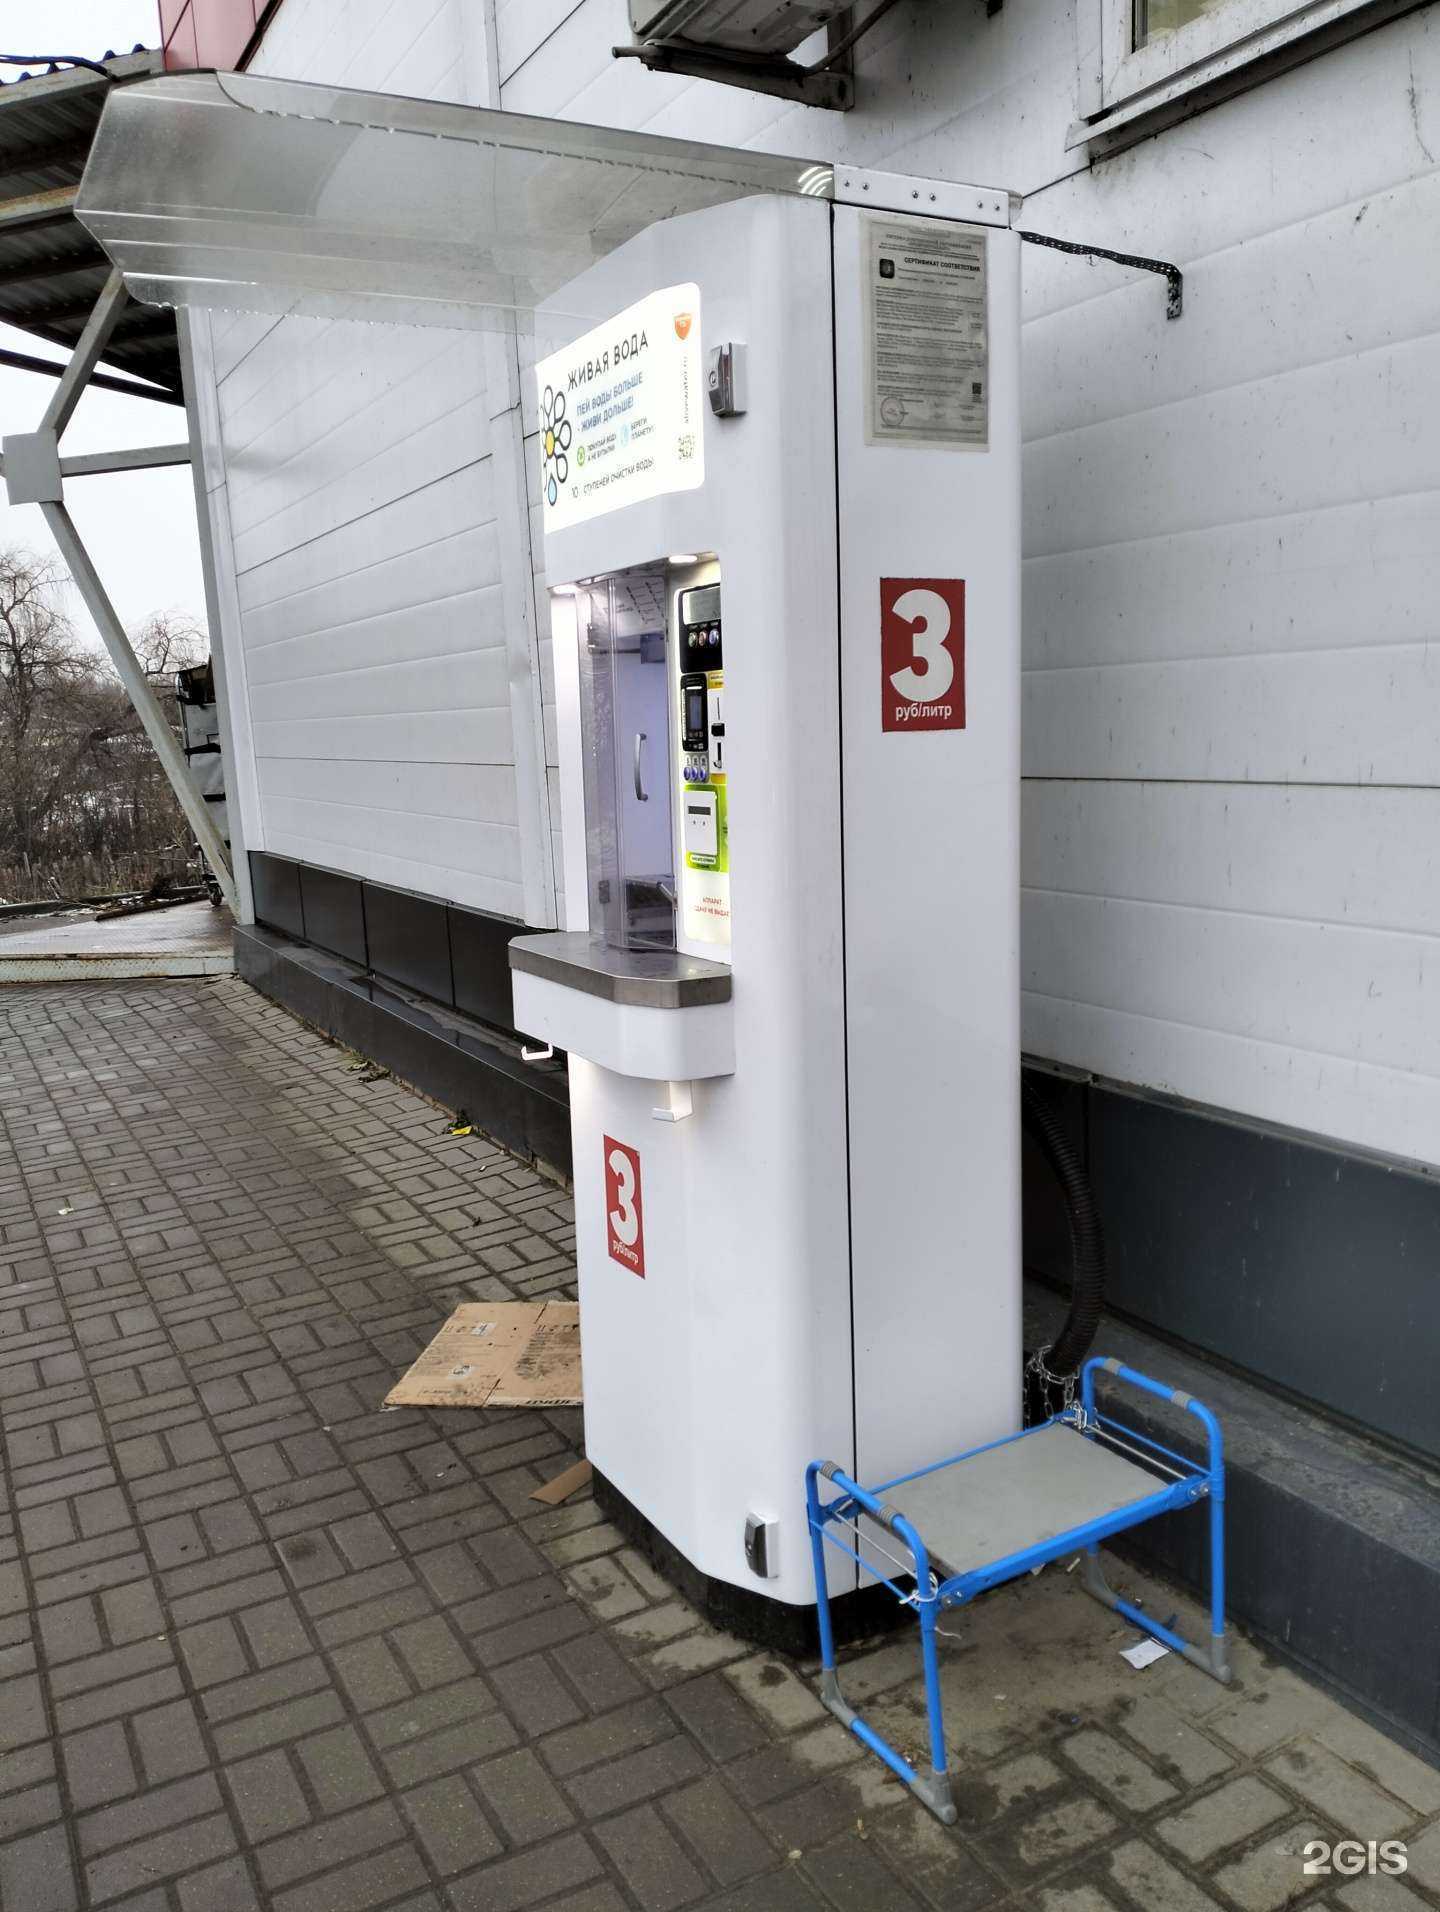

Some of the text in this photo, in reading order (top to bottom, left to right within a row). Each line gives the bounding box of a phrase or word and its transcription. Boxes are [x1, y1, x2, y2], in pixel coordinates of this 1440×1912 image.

[940, 262, 980, 272] СООТВЕТСТВИЯ
[567, 330, 648, 392] ЖИВАЯ ВОДА
[577, 372, 643, 416] ПЕЙ ВОДЫ БОЛЬШЕ
[581, 413, 602, 432] ЖИВИ
[603, 396, 634, 424] ДОЛЬШЕ!
[584, 475, 609, 494] СТУПЕНЕЙ
[611, 465, 635, 482] ОЧИСТКИ
[889, 588, 954, 703] 3
[895, 702, 952, 721] руб/литр
[608, 1149, 639, 1246] 3
[612, 1240, 639, 1265] руб/литр
